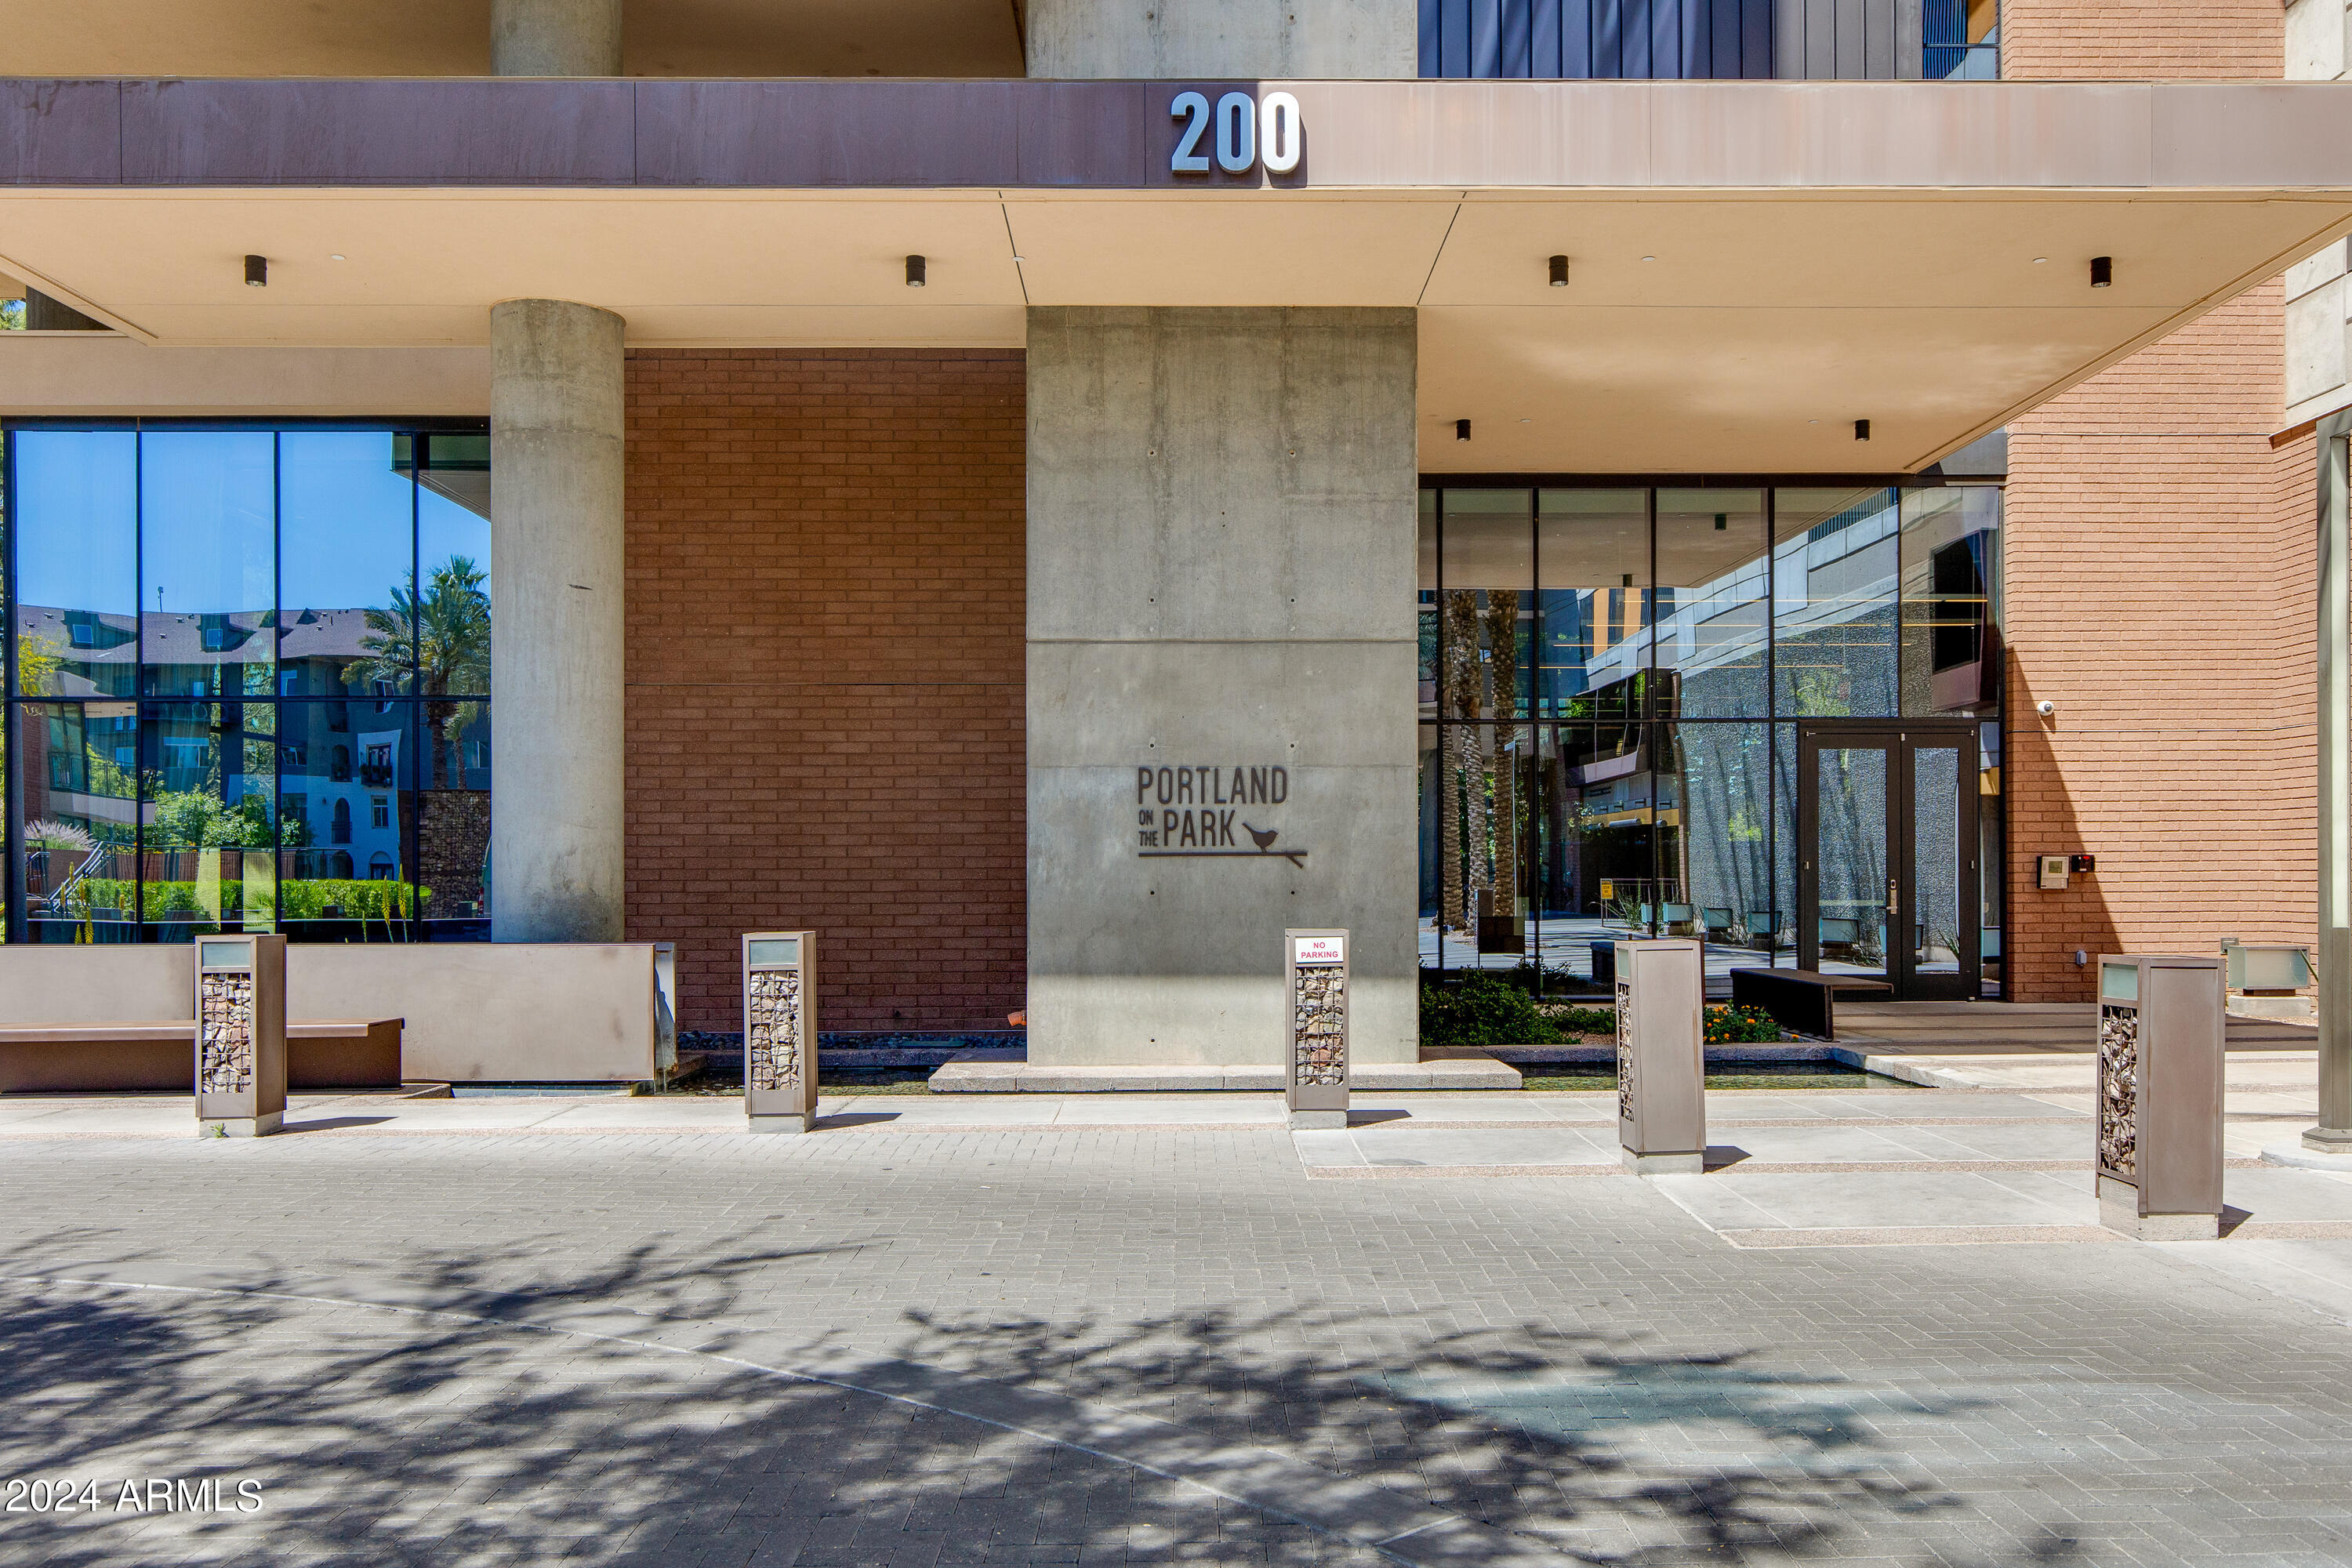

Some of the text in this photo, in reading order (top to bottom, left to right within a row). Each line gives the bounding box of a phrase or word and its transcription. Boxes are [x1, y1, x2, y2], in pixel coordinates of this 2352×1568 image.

[1171, 91, 1300, 174] 200
[1138, 766, 1287, 804] PORTLAND
[1138, 809, 1153, 826] ON
[1163, 809, 1236, 847] PARK
[1138, 830, 1158, 847] THE
